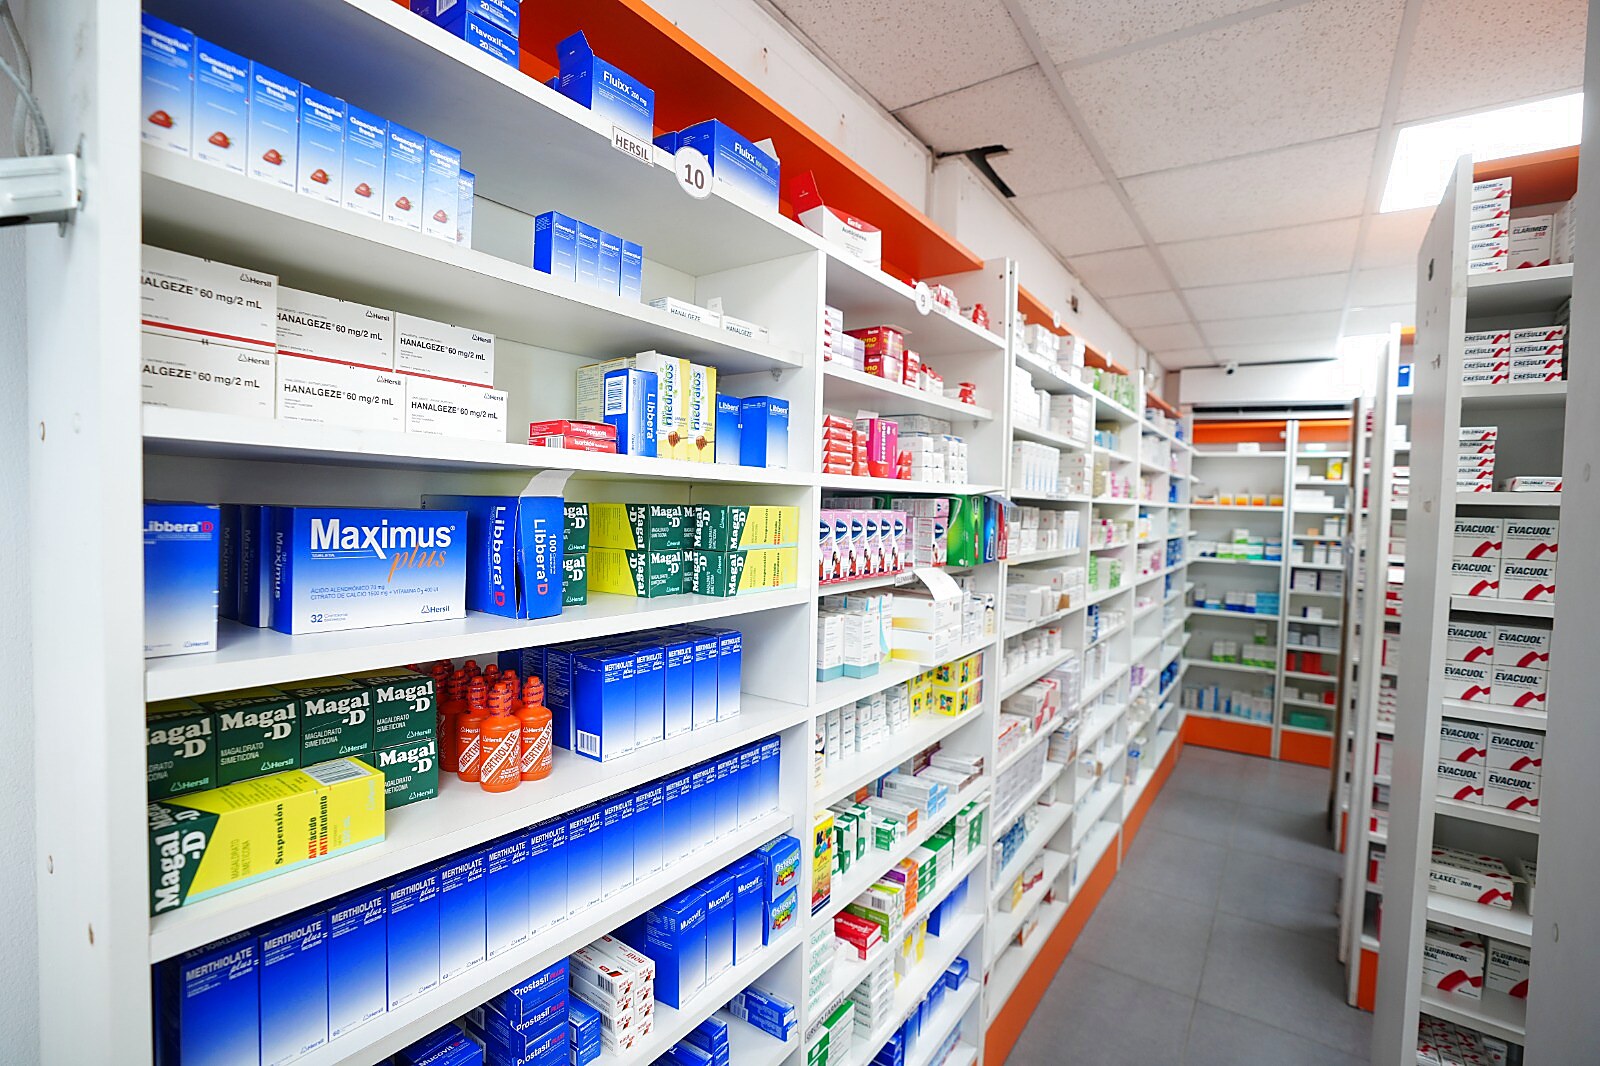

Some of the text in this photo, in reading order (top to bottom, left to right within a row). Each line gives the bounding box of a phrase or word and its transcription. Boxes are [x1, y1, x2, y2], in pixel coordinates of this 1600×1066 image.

[470, 23, 502, 46] Flavoxil
[603, 70, 630, 94] Fluixx
[615, 134, 649, 161] HERSIL
[734, 142, 755, 164] Fluixx
[684, 163, 704, 190] 10
[250, 277, 272, 288] Hersil
[200, 289, 262, 309] 60 mg/2 mL
[920, 294, 926, 307] 9
[373, 313, 390, 322] Hersil
[277, 313, 383, 341] HANALGEZE 60 mg/2 mL
[1514, 331, 1548, 339] CRESULEN
[1464, 334, 1495, 342] CRESULEN
[400, 337, 486, 361] HANALGEZE 60 mg/2 mL
[1514, 345, 1548, 353] CRESULEN
[248, 356, 270, 366] Hersil
[1513, 359, 1547, 367] CRESULEN
[198, 372, 260, 388] 60 mg/2 mL
[384, 377, 402, 386] Hersil
[1513, 372, 1547, 380] CRESULEN
[284, 383, 394, 406] HANALGEZE 60 mg/2 mL
[411, 401, 457, 414] HANALGEZE
[469, 409, 487, 419] mg/2
[487, 412, 498, 420] mL
[718, 401, 738, 412] Libbera
[646, 393, 655, 440] Libbera
[629, 506, 637, 523] -D
[650, 505, 682, 519] Magal
[703, 510, 711, 526] -D
[738, 511, 746, 527] -D
[201, 521, 213, 533] D
[570, 518, 586, 529] -D
[635, 507, 646, 549] Magal
[668, 517, 680, 527] -D
[693, 507, 704, 547] Magal
[729, 508, 740, 550] Magal
[1454, 524, 1496, 533] EVACUOL
[1507, 526, 1552, 535] EVACUOL
[310, 518, 452, 560] Maximus
[549, 533, 557, 553] 100
[387, 541, 447, 584] plus
[493, 505, 506, 607] Libbera D
[533, 519, 549, 595] Libbera D
[650, 552, 681, 565] Magal
[700, 555, 708, 571] -D
[736, 556, 744, 572] -D
[274, 531, 284, 600] Maximus
[667, 563, 680, 574] -D
[692, 552, 700, 592] Magal
[1452, 562, 1493, 572] EVACUOL
[1505, 566, 1549, 576] EVACUOL
[636, 553, 646, 596] Magal
[728, 553, 738, 595] Magal
[430, 605, 450, 613] Hersil
[310, 613, 324, 623] 32
[1447, 628, 1488, 639] EVACUOL
[1498, 633, 1542, 644] EVACUOL
[695, 642, 717, 652] MERTHIOLATE
[720, 637, 741, 647] MERTHIOLATE
[636, 652, 663, 664] MERTHIOLATE
[668, 647, 692, 658] MERTHIOLATE
[604, 660, 634, 673] MERTHIOLATE
[1444, 666, 1485, 678] EVACUOL
[1495, 672, 1538, 684] EVACUOL
[376, 680, 434, 704] Magal
[305, 691, 370, 717] Magal
[409, 697, 431, 713] -D
[220, 702, 297, 732] Magal
[341, 709, 366, 726] -D
[376, 713, 410, 726] MAGALDRATO
[146, 717, 212, 746] agal
[263, 722, 292, 740] -D
[304, 727, 342, 741] MAGALDRATO
[376, 722, 406, 733] SIMETICONA
[414, 728, 432, 738] Hersil
[1440, 727, 1481, 741] EVACUOL
[173, 738, 207, 758] -D
[220, 741, 264, 757] MAGALDRATO
[304, 736, 338, 749] SIMETICONA
[346, 743, 368, 753] Hersil
[1491, 736, 1535, 749] EVACUOL
[220, 751, 260, 766] SIMETICONA
[379, 741, 436, 768] Magal
[481, 732, 517, 778] MERTHIOLATE
[270, 758, 294, 769] Hersil
[411, 758, 433, 774] -D
[692, 766, 715, 780] MERTHIOLATE
[1437, 765, 1478, 779] EVACUOL
[182, 777, 210, 789] Hersil
[666, 776, 690, 791] MERTHIOLATE
[1488, 774, 1532, 789] EVACUOL
[416, 788, 434, 798] Hersil
[635, 787, 662, 803] MERTHIOLATE
[604, 799, 632, 816] MERTHIOLATE
[319, 795, 328, 856] ANTIflatulento
[569, 811, 600, 830] MERTHIOLATE
[275, 803, 284, 865] Suspensión
[308, 816, 317, 859] ANTIácido
[530, 826, 565, 845] MERTHIOLATE
[182, 830, 206, 860] -D
[488, 841, 527, 862] MERTHIOLATE
[154, 830, 186, 913] Magal
[441, 857, 483, 880] MERTHIOLATE
[390, 876, 436, 901] MERTHIOLATE
[419, 886, 435, 899] plus
[737, 877, 760, 894] Mucovit
[708, 891, 731, 910] Mucovit
[331, 896, 382, 924] MERTHIOLATE
[363, 907, 382, 921] plus
[680, 909, 702, 931] Mucovit
[264, 919, 322, 951] MERTHIOLATE
[301, 931, 322, 948] plus
[186, 946, 253, 982] MERTHIOLATE
[228, 958, 253, 977] plus
[514, 974, 549, 997] Prostasil
[516, 1007, 550, 1031] Prostasil
[418, 1045, 454, 1066] Mucovit
